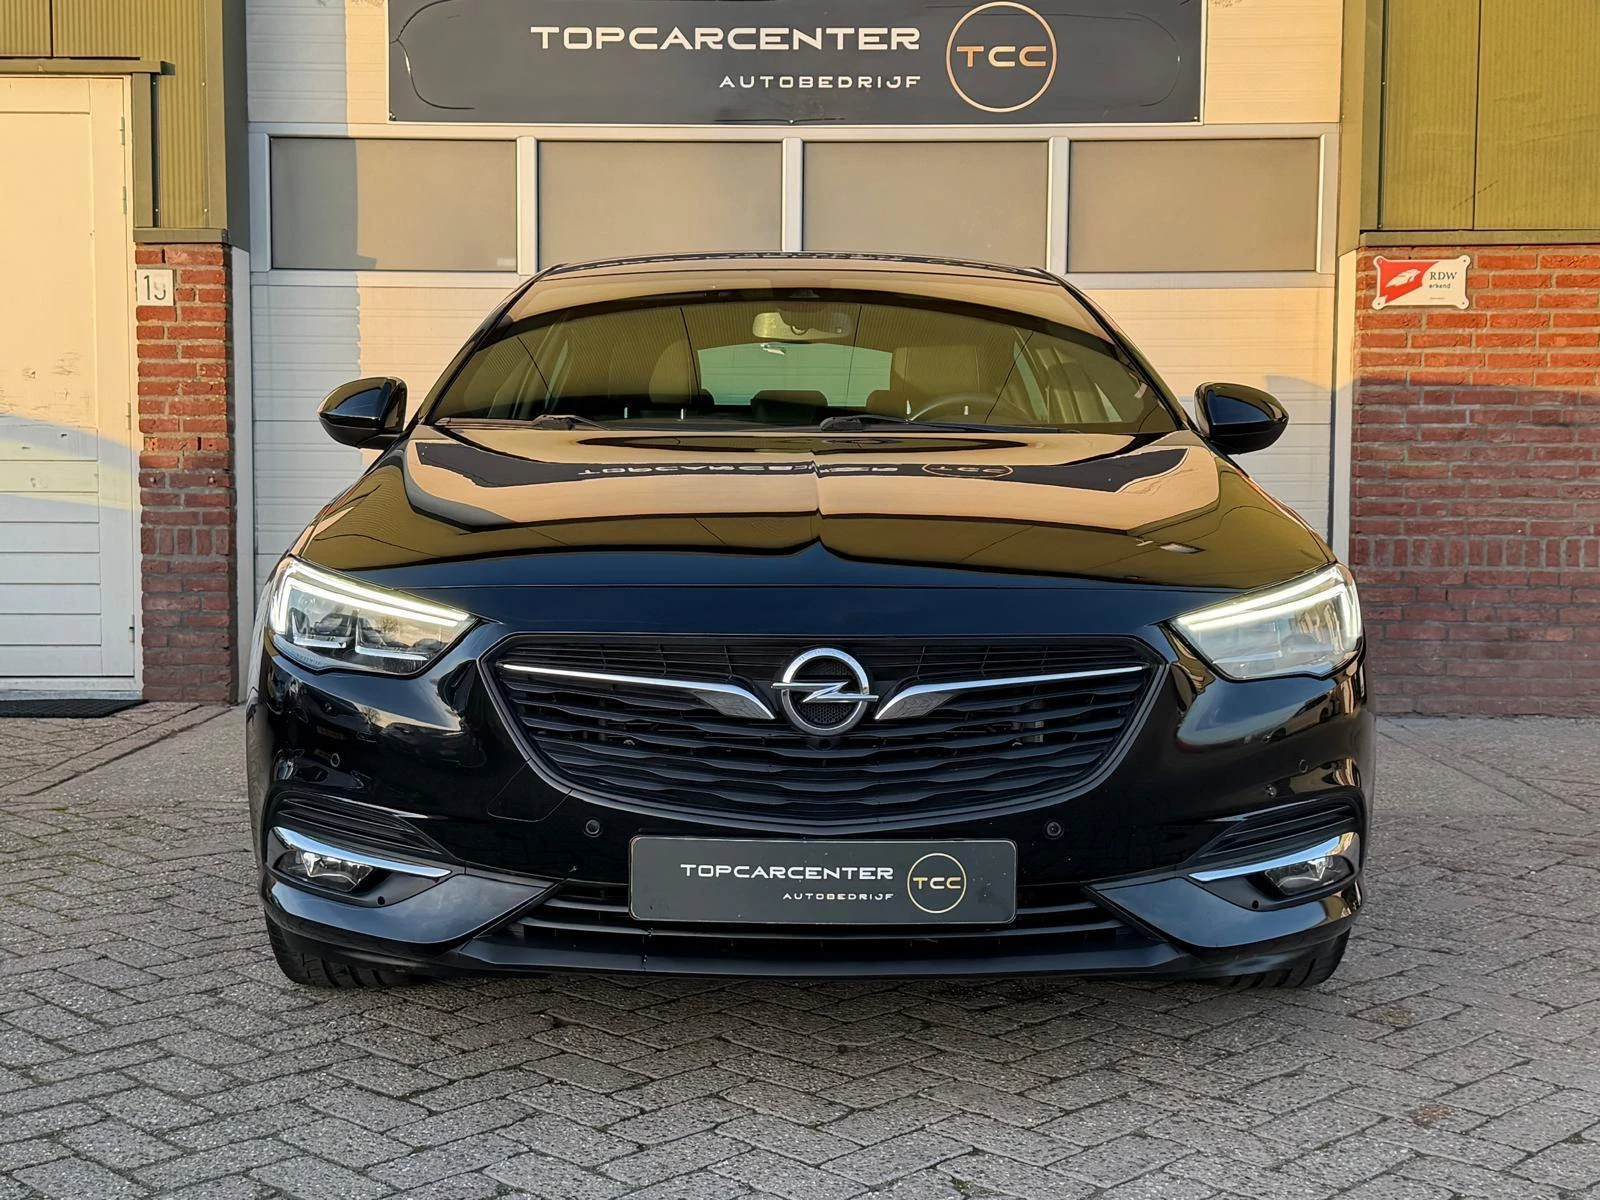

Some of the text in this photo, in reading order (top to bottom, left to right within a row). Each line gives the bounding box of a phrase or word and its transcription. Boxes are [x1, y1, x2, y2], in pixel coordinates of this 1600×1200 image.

[530, 26, 921, 51] TOPCARCENTER
[956, 45, 1048, 68] TCC
[719, 75, 921, 89] AUTOBEDRIJF
[1429, 271, 1457, 280] RDW
[680, 863, 894, 880] TOPCARCENTER
[912, 876, 962, 889] TCC
[782, 892, 895, 901] AUTOBEDRIJF
